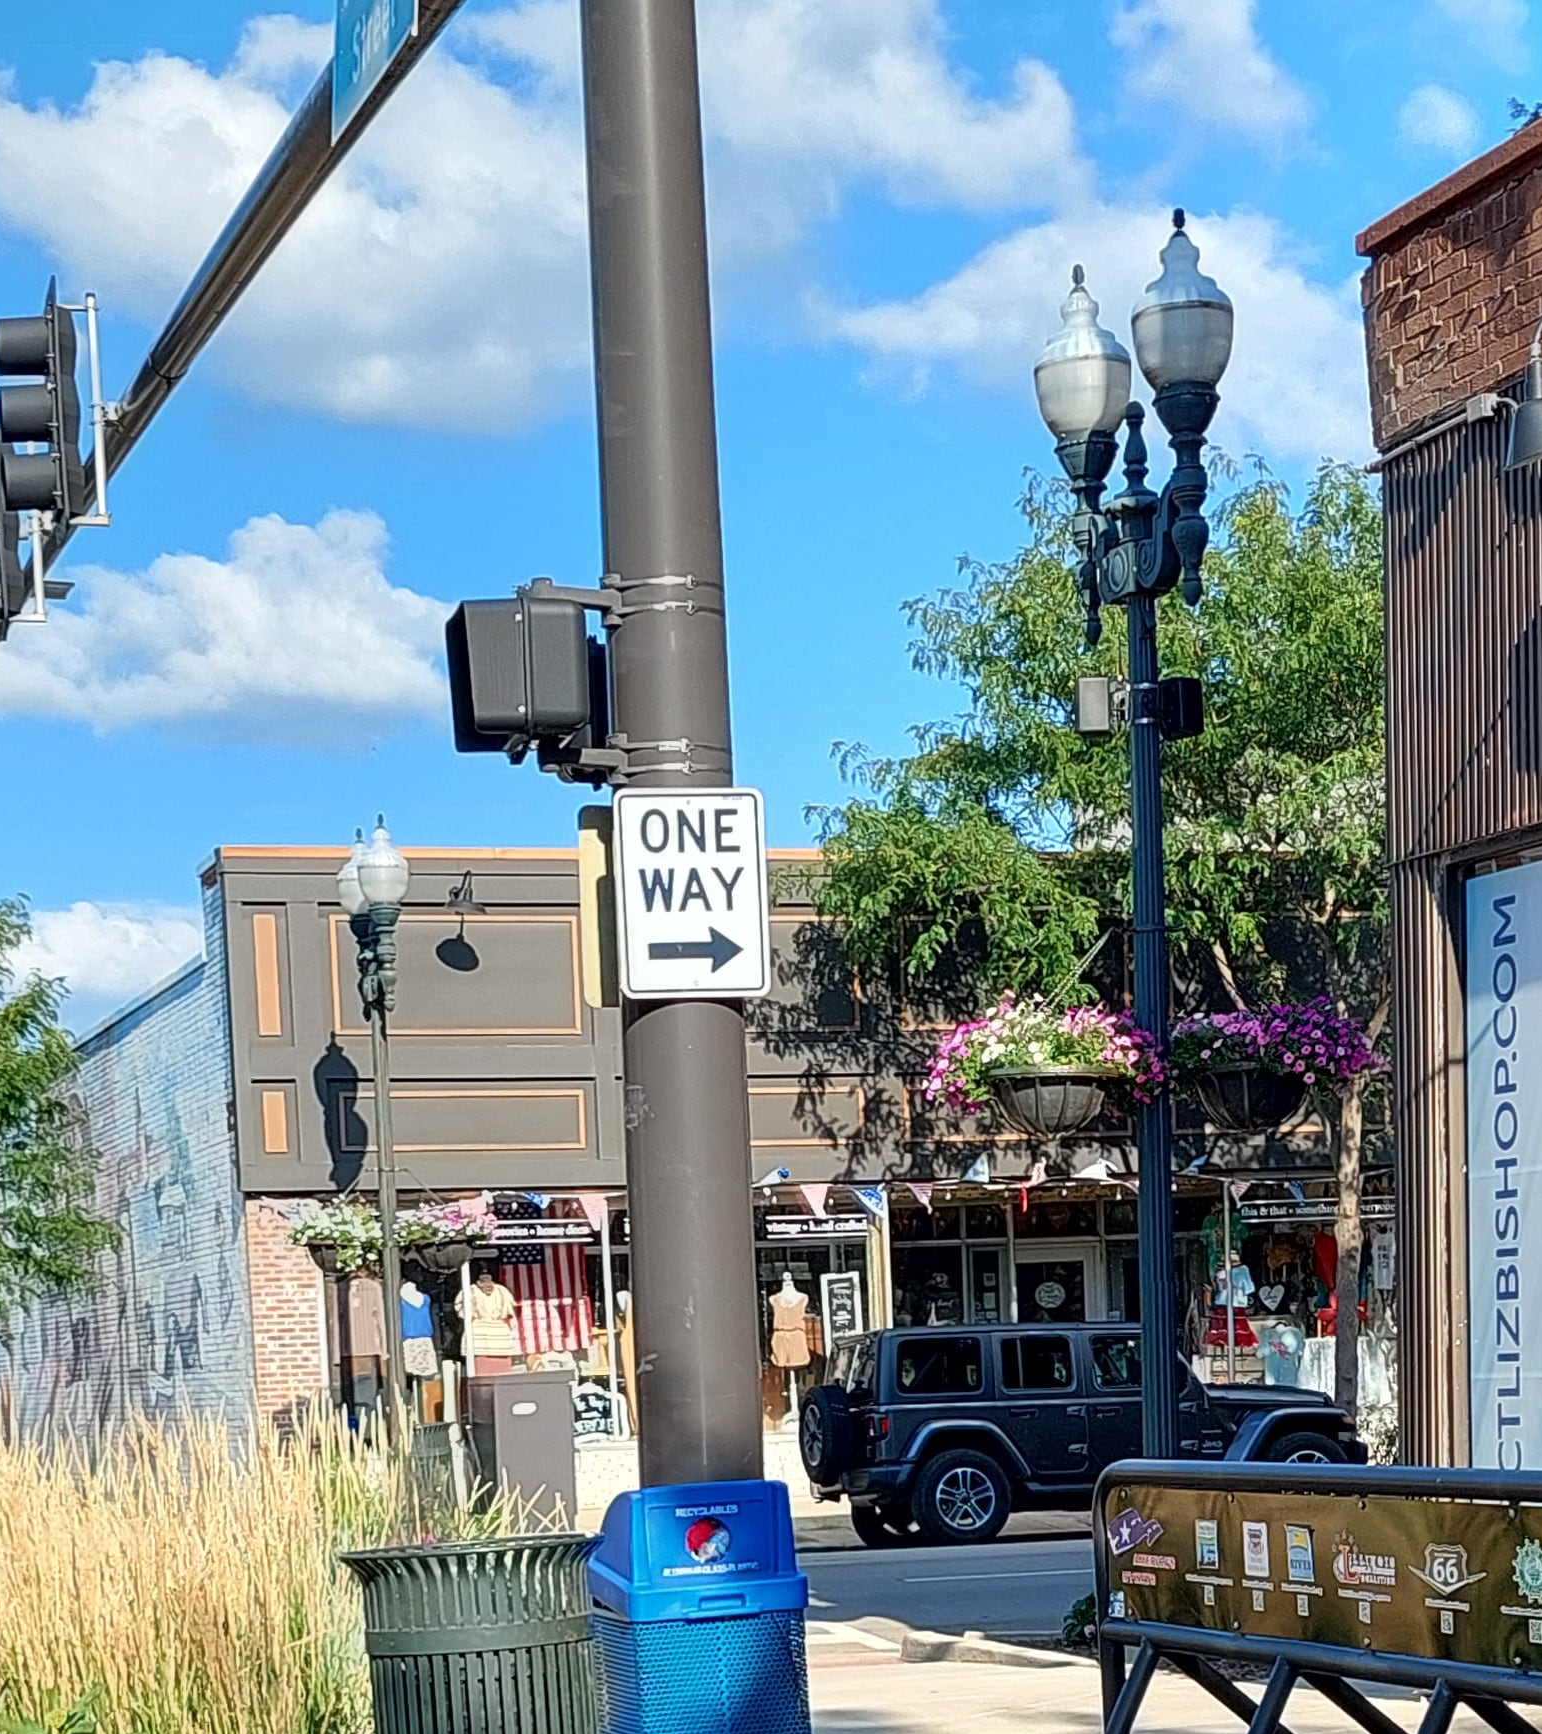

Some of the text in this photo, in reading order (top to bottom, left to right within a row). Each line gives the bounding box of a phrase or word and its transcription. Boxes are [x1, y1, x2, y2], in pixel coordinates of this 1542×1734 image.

[640, 808, 741, 853] ONE
[638, 867, 744, 912] WAY
[1241, 1206, 1258, 1217] this
[1259, 1206, 1268, 1216] &
[1269, 1204, 1287, 1216] that
[765, 1222, 802, 1234] vintage
[675, 1504, 738, 1517] RECYCLABLES
[1432, 1557, 1458, 1584] 66
